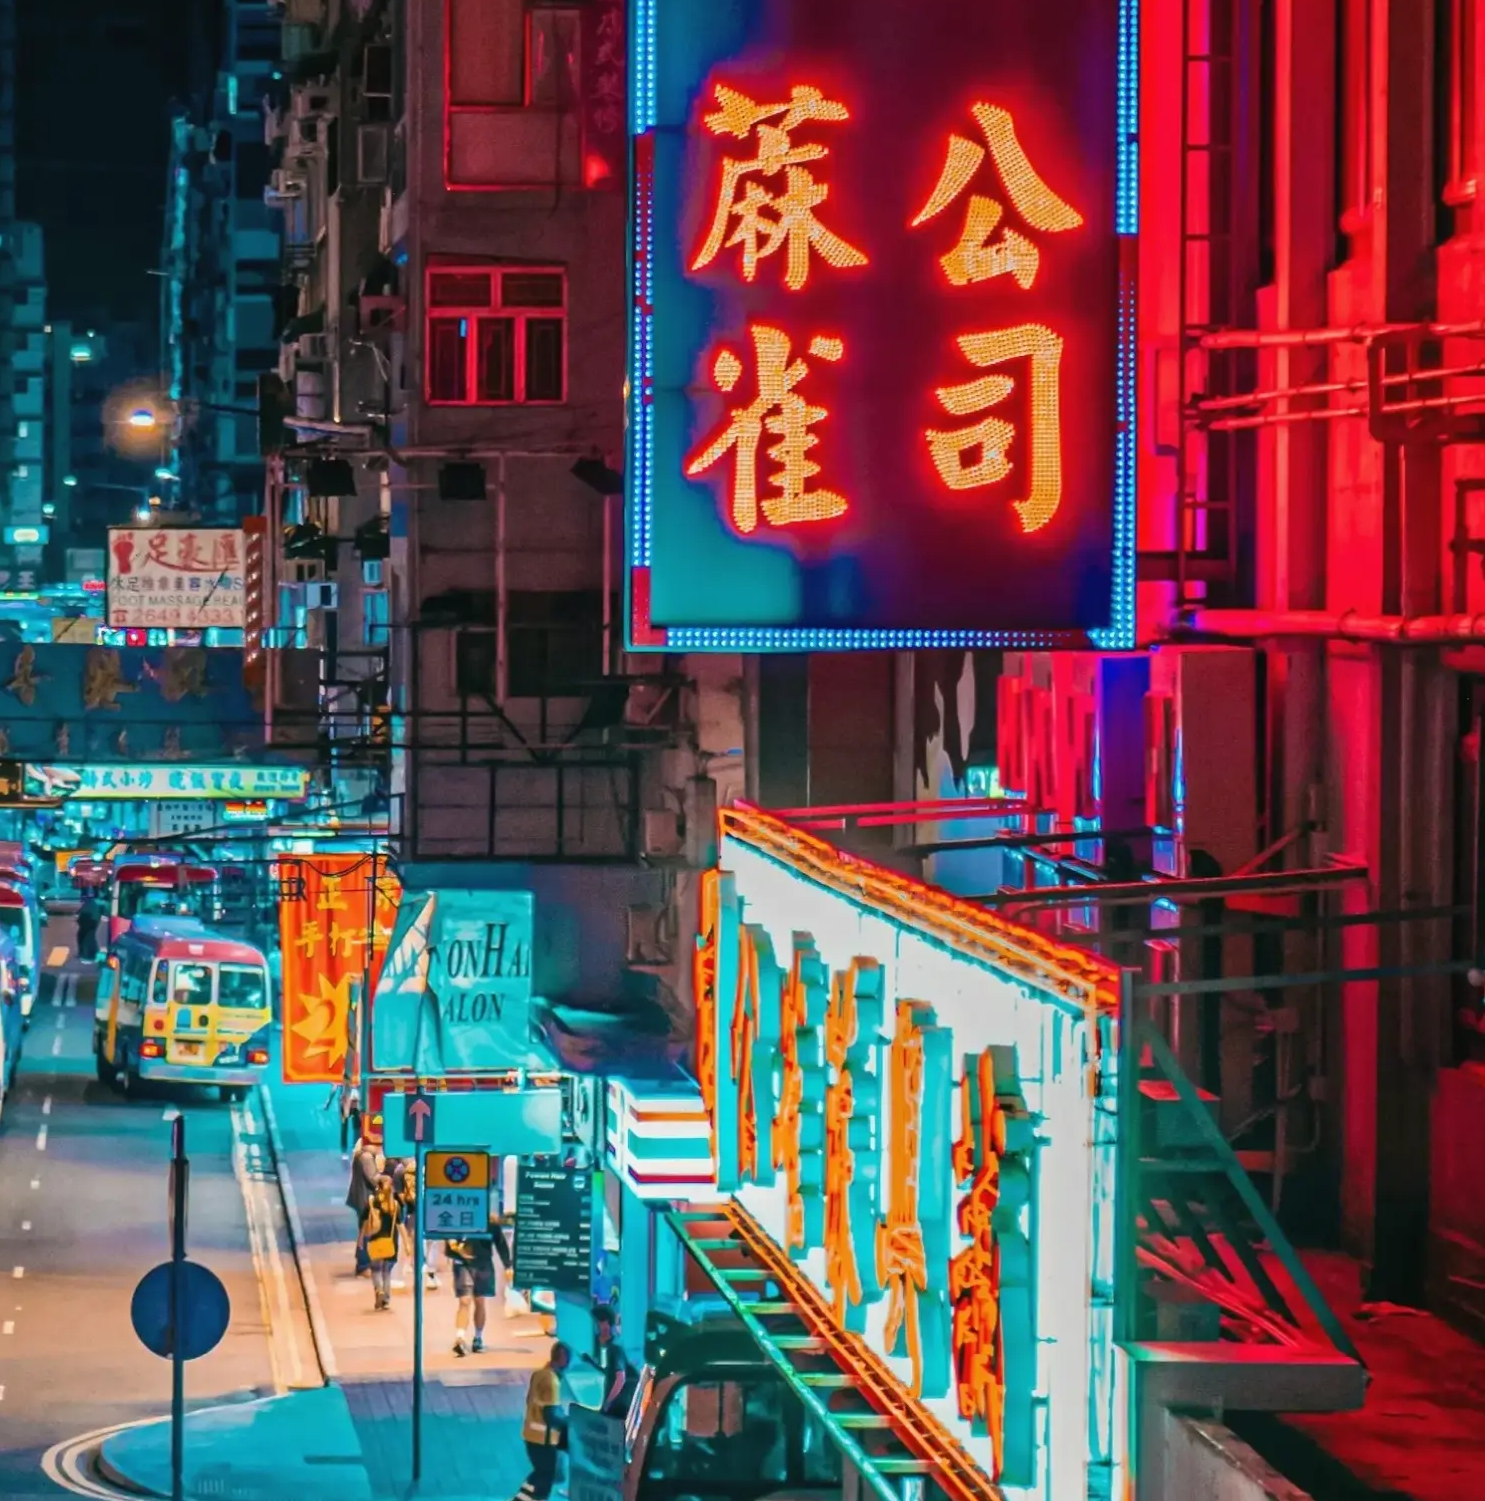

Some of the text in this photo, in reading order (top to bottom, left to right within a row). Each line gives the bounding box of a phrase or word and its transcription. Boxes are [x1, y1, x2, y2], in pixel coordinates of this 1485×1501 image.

[912, 101, 1084, 533] 公司
[442, 992, 505, 1024] ALON
[433, 1193, 480, 1206] 24 hrs
[437, 1210, 474, 1227] 全日
